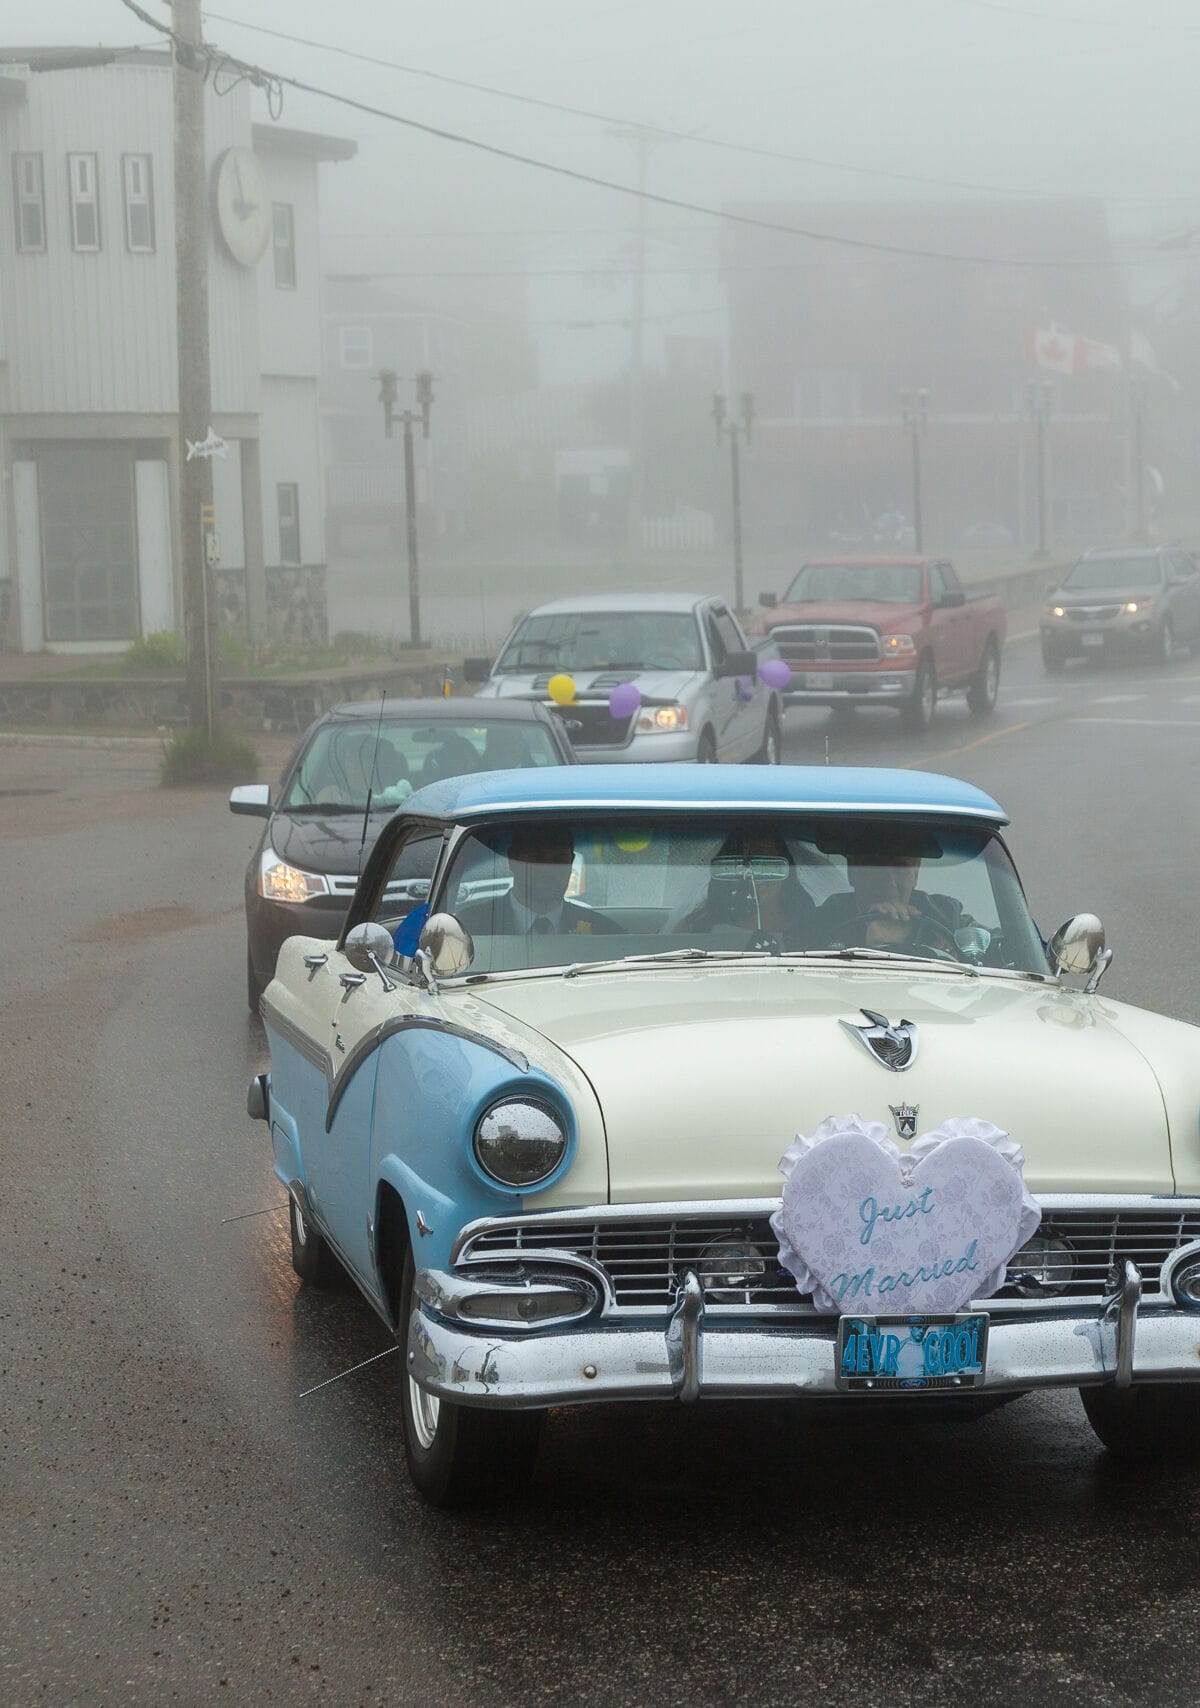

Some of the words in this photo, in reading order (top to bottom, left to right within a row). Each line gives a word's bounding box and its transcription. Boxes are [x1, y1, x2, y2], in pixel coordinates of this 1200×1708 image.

[859, 1187, 936, 1245] Just
[831, 1239, 979, 1302] Married
[842, 1333, 901, 1373] 4EVR
[924, 1329, 982, 1371] COOL
